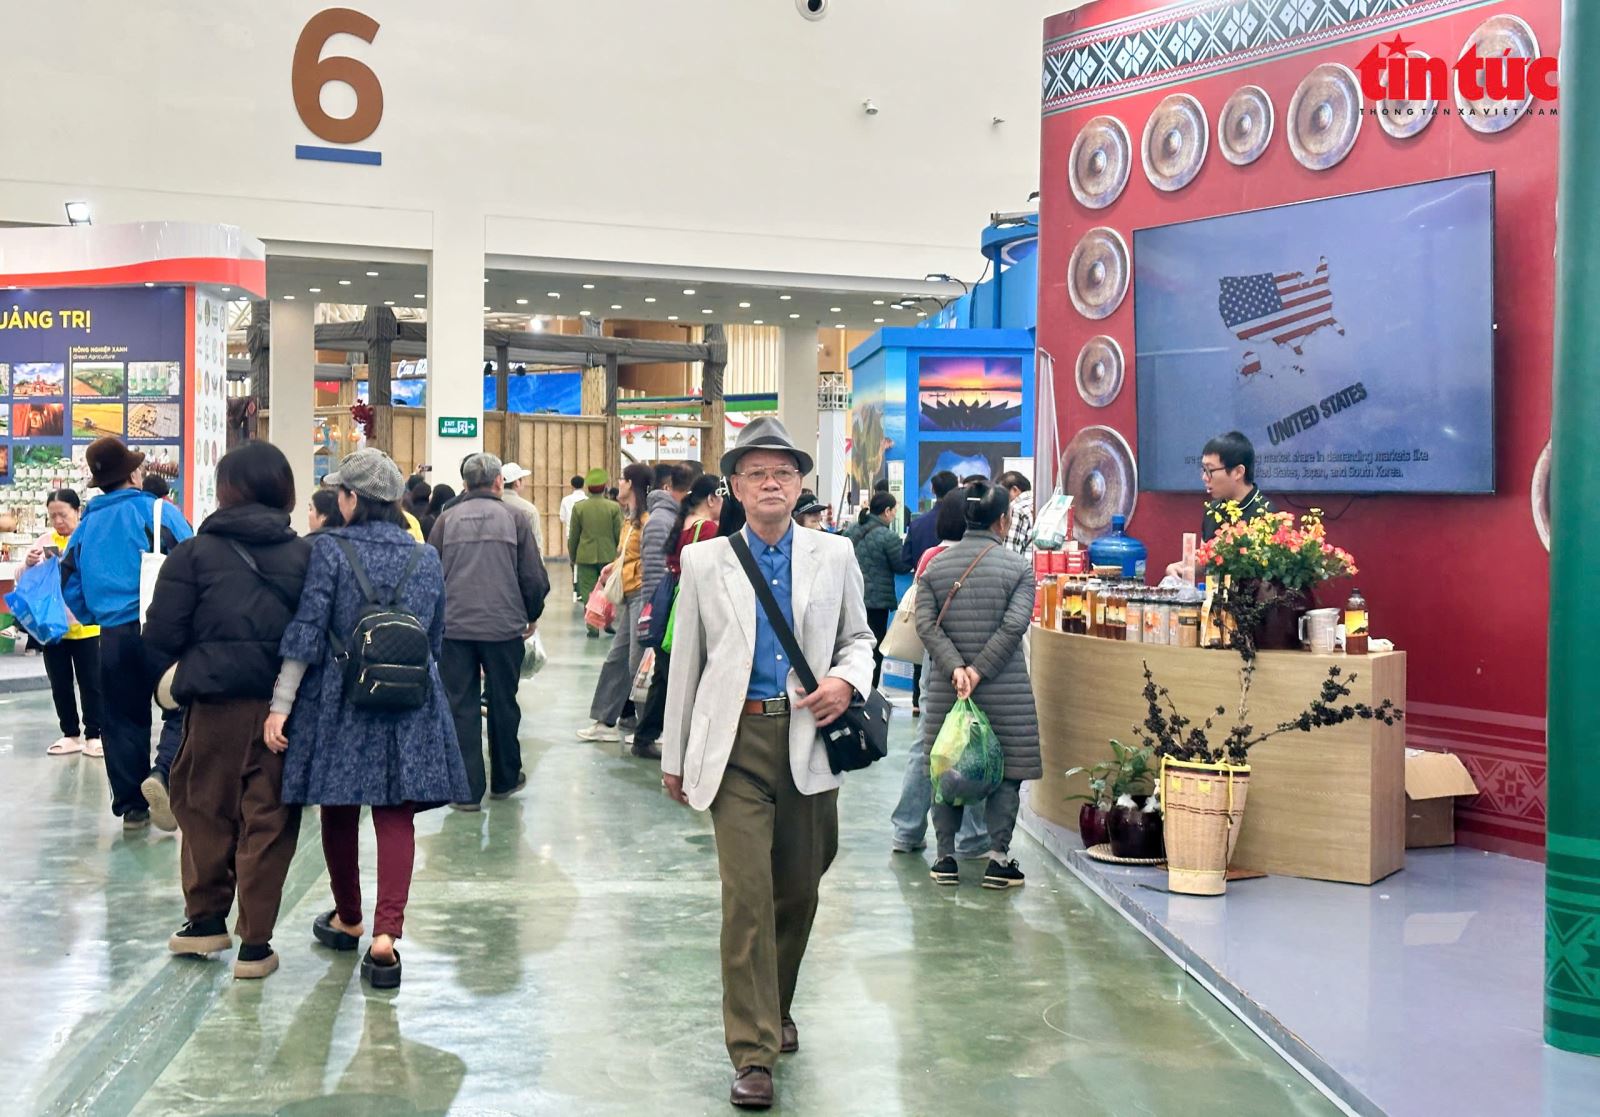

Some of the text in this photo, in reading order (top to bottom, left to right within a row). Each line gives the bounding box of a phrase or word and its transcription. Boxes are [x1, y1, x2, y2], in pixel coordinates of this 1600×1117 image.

[292, 8, 384, 144] 6
[59, 310, 91, 333] TRỊ
[1267, 382, 1368, 446] UNITED STATES
[1327, 449, 1373, 465] demanding
[1375, 448, 1411, 462] markets
[1412, 447, 1429, 462] like
[1330, 466, 1347, 478] and
[1349, 466, 1374, 478] South
